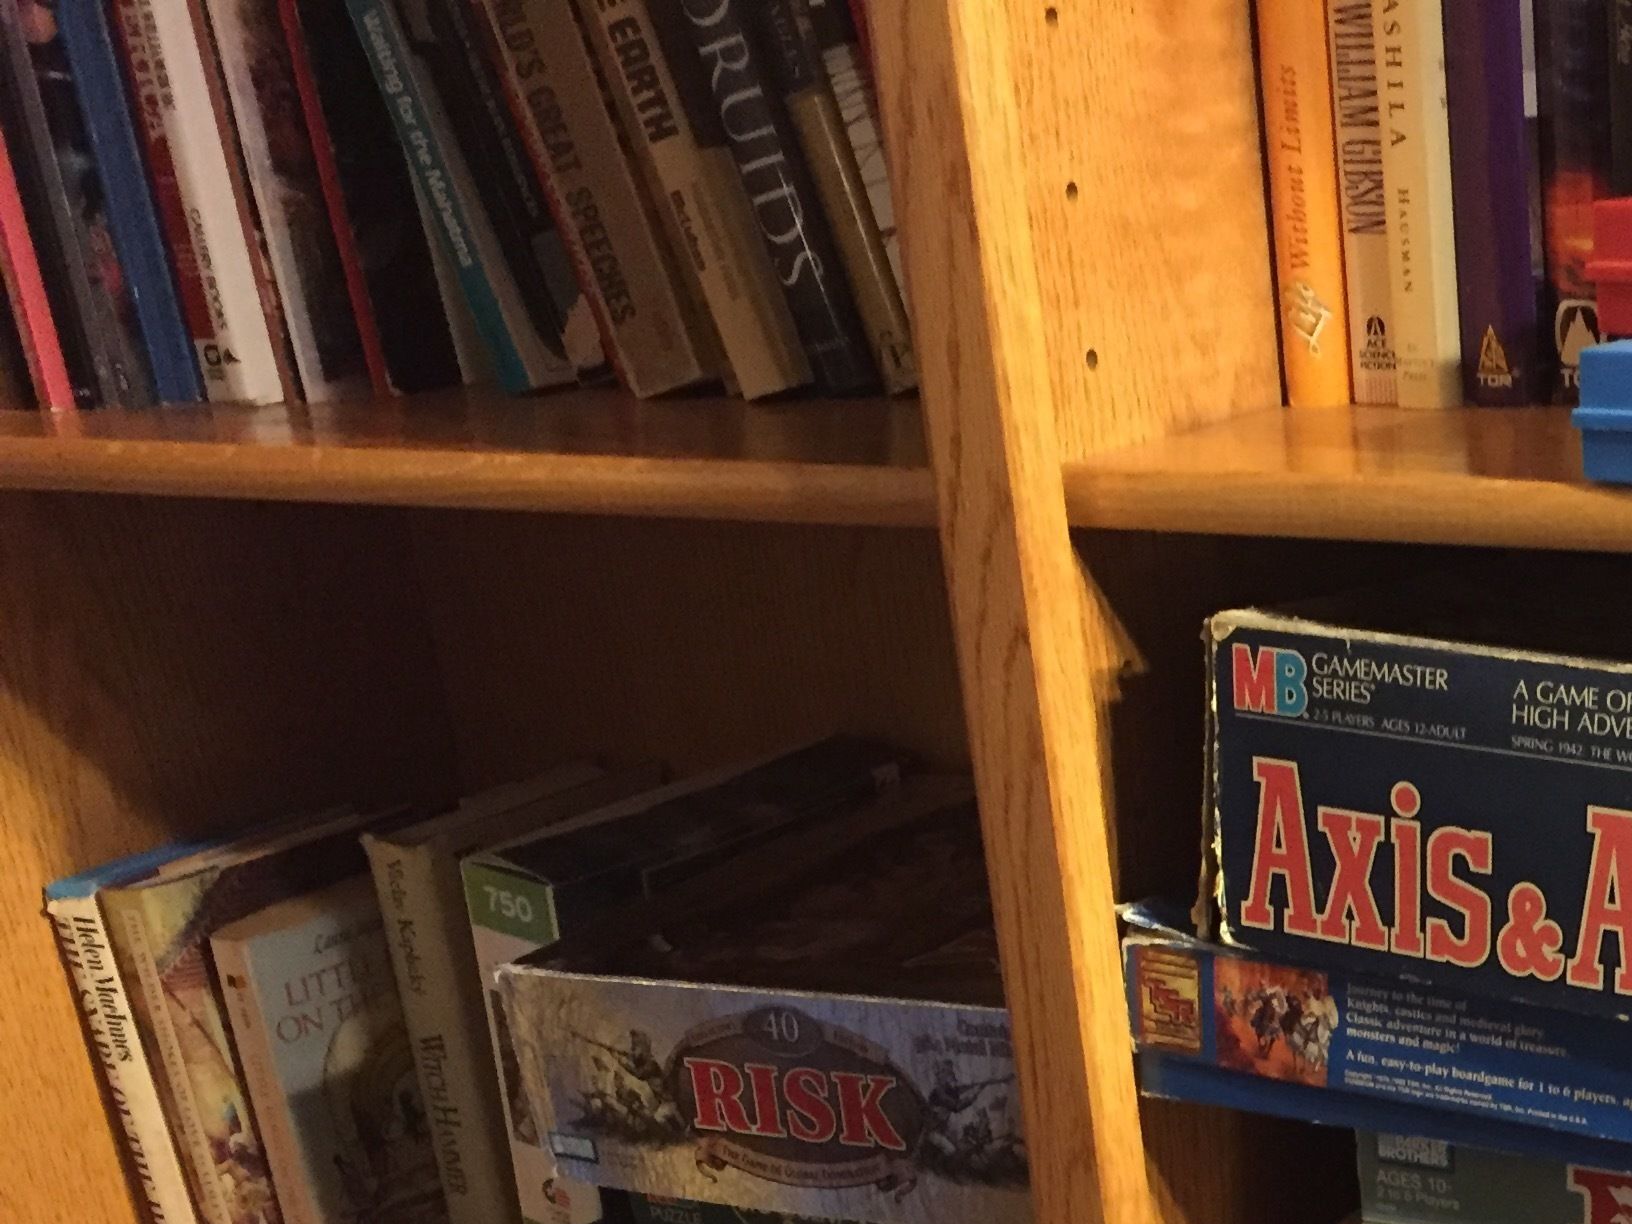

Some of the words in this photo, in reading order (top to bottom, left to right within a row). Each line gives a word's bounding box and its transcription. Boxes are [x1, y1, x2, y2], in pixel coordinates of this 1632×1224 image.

[362, 7, 404, 96] Waiting
[1333, 2, 1380, 129] WILLIAM
[607, 16, 680, 144] EARTH
[395, 94, 418, 128] for
[1281, 64, 1305, 155] Limits
[406, 128, 434, 167] the
[526, 85, 583, 175] GREAT
[567, 185, 637, 326] SPEECHES
[1341, 136, 1387, 237] GIBSON
[1281, 162, 1312, 274] Without
[1366, 339, 1388, 350] ACE
[1360, 360, 1397, 371] FICTION
[1232, 642, 1308, 717] MB
[1311, 652, 1450, 692] GAMEMASTER
[1311, 677, 1372, 705] SERIES
[1512, 679, 1529, 700] A
[1535, 680, 1600, 710] GAME
[1331, 711, 1376, 731] PLAYERS
[1380, 716, 1412, 735] AGES
[1413, 721, 1468, 741] 12-ADULT
[1511, 702, 1570, 732] HIGH
[1510, 733, 1555, 754] SPRING
[1589, 744, 1613, 762] THE
[1240, 756, 1494, 969] Axis
[1497, 881, 1565, 981] &
[482, 885, 533, 924] 750
[73, 915, 106, 972] Helen
[1406, 991, 1424, 1005] the
[275, 1005, 325, 1045] ON
[761, 1012, 799, 1044] 40
[1346, 1011, 1383, 1028] Classic
[1386, 1019, 1442, 1038] adventure
[1445, 1027, 1457, 1040] in
[1469, 1031, 1503, 1047] world
[1505, 1036, 1517, 1049] of
[1346, 1026, 1397, 1044] monsters
[1399, 1034, 1420, 1048] and
[1435, 1012, 1457, 1024] and
[418, 1034, 449, 1102] WITCH
[1346, 1049, 1355, 1061] A
[1381, 1057, 1451, 1080] easy-to-play
[1452, 1066, 1516, 1090] boardgame
[1518, 1077, 1534, 1092] for
[1548, 1084, 1561, 1096] to
[1562, 1086, 1571, 1098] 6
[684, 1056, 907, 1151] RISK
[433, 1103, 469, 1196] HAMMER
[1378, 1144, 1450, 1168] BROTHERS
[1376, 1168, 1422, 1190] AGES
[1387, 1188, 1402, 1200] to
[1414, 1190, 1461, 1212] Players
